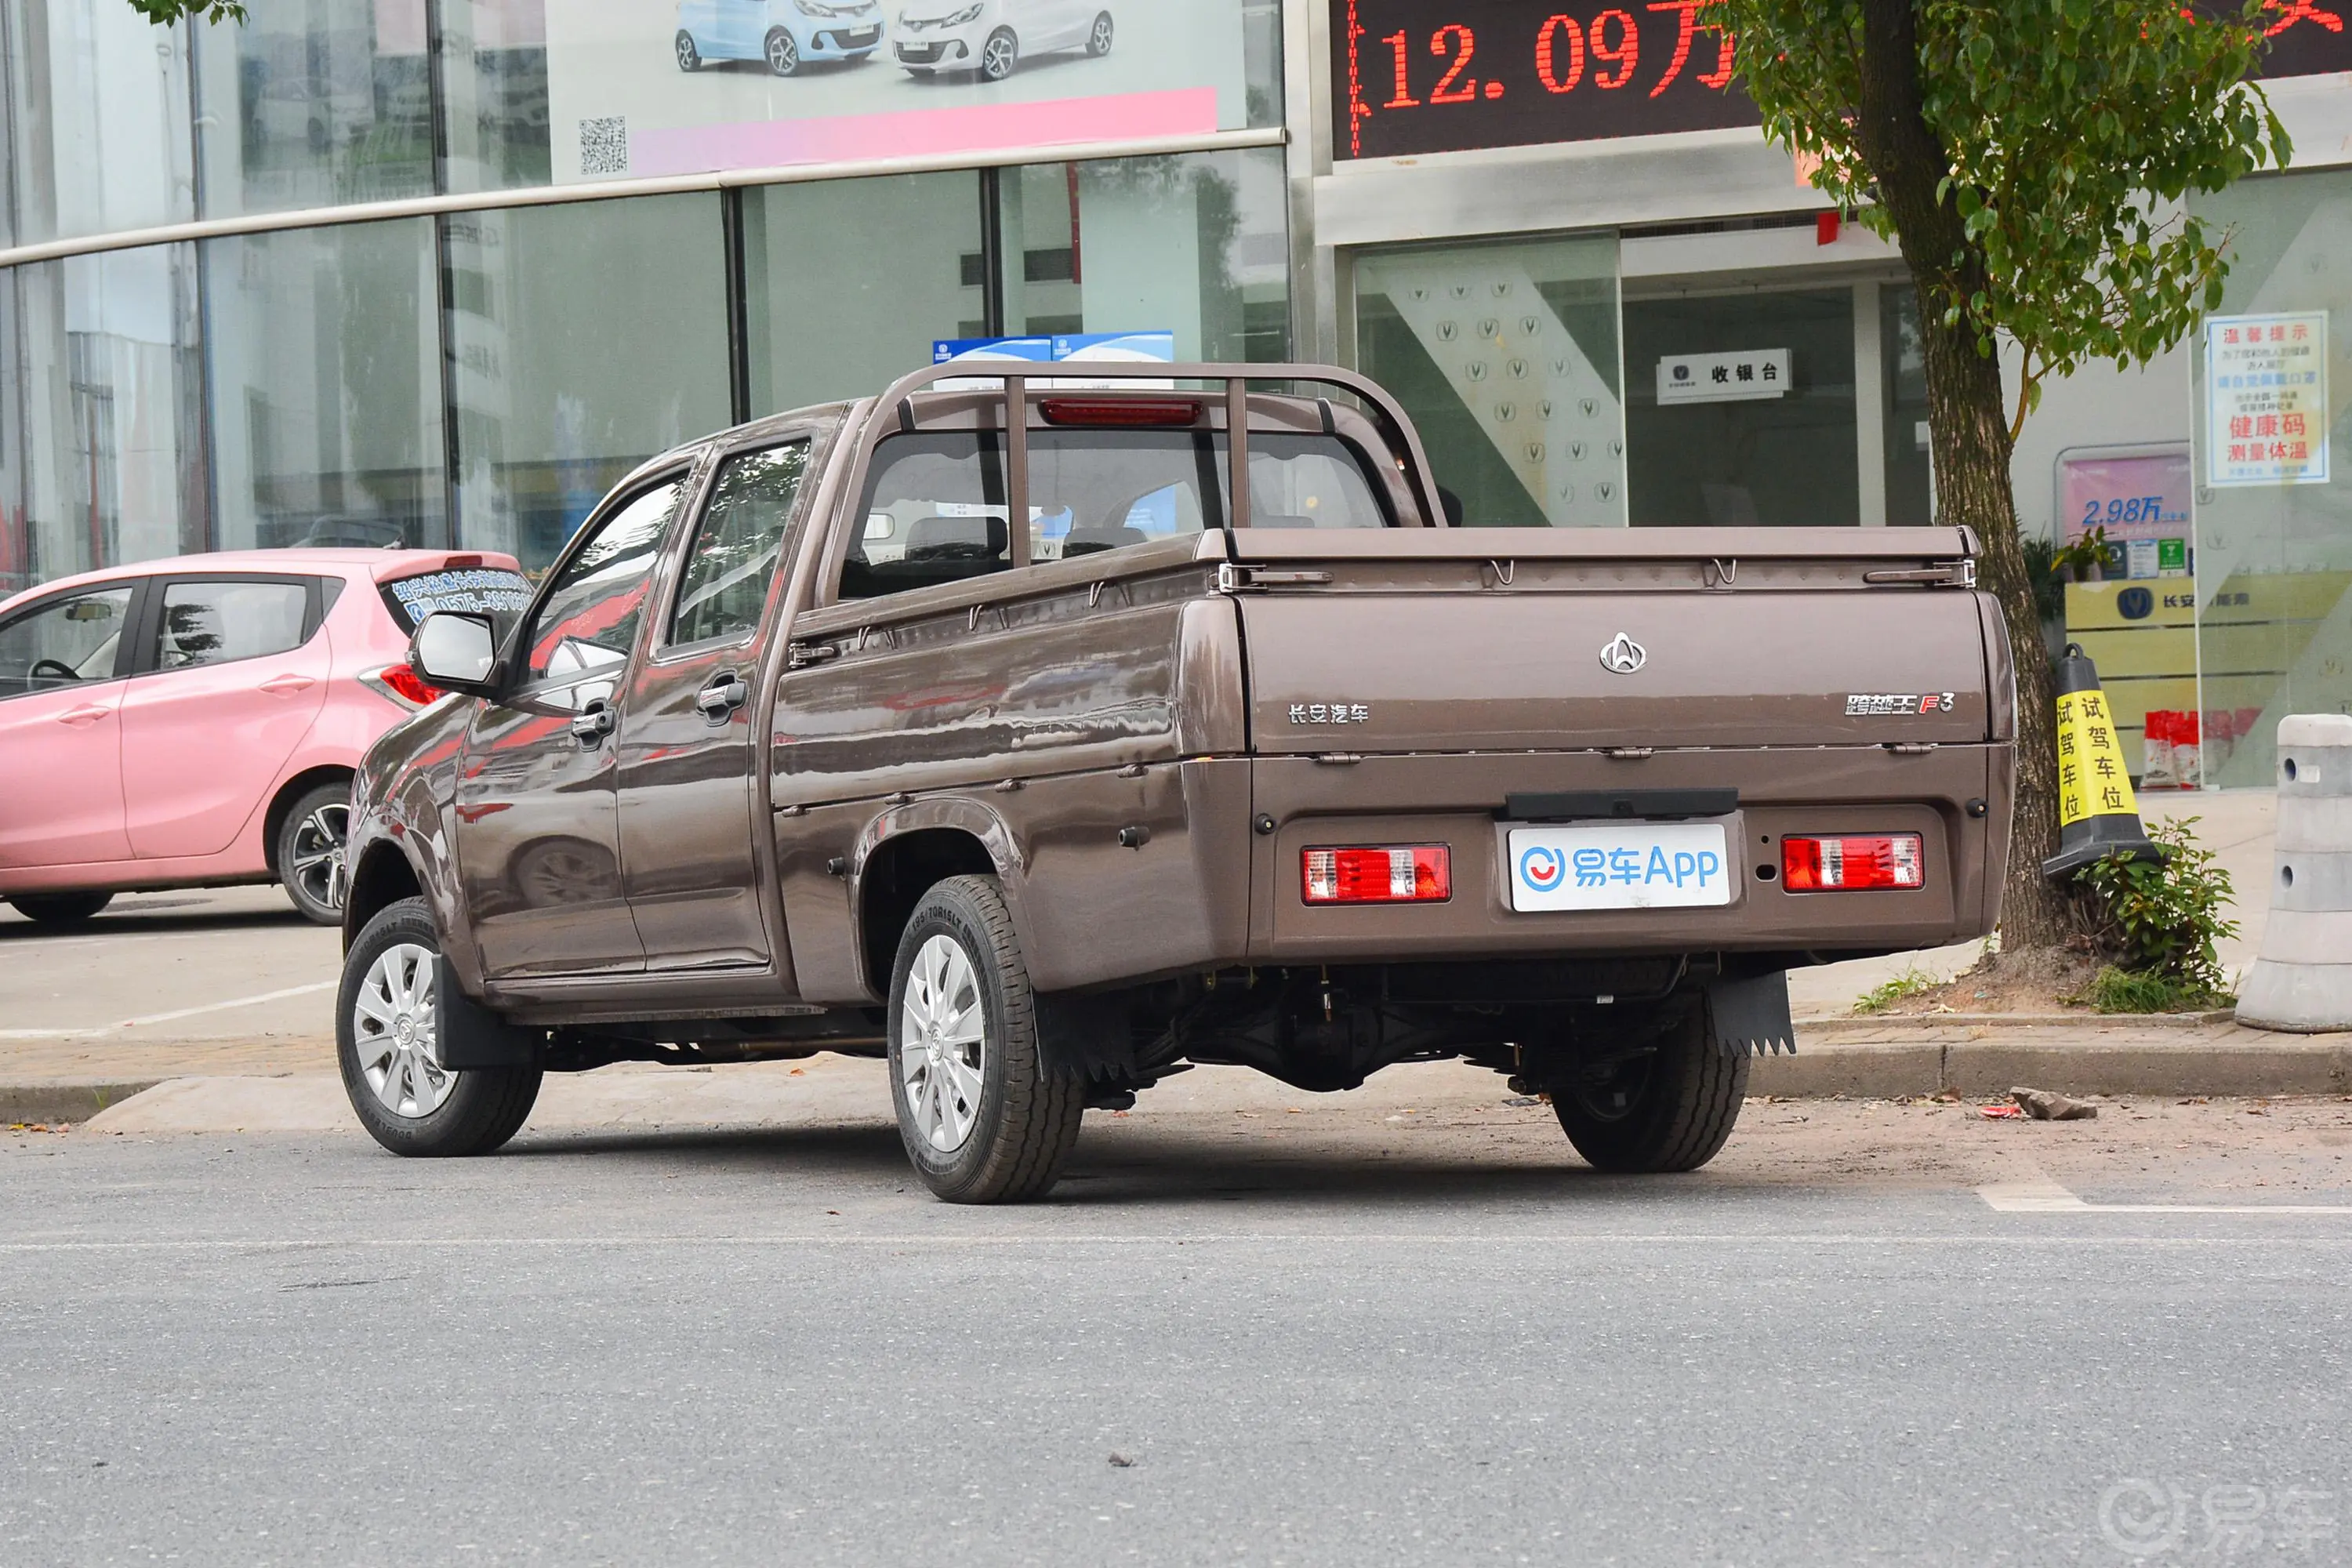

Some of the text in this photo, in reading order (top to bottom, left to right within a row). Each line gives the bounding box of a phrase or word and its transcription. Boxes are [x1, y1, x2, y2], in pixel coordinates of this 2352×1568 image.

[2223, 324, 2308, 343] 温馨提示
[1711, 362, 1777, 383] 收银台
[2229, 413, 2306, 440] 健康码
[2227, 441, 2308, 462] 测量体温
[2082, 495, 2164, 526] 2.98万
[1288, 703, 1369, 724] 长安汽车
[2057, 701, 2080, 820] 试驾车位
[2082, 697, 2124, 810] 试驾车位
[1573, 846, 1719, 888] 易车App
